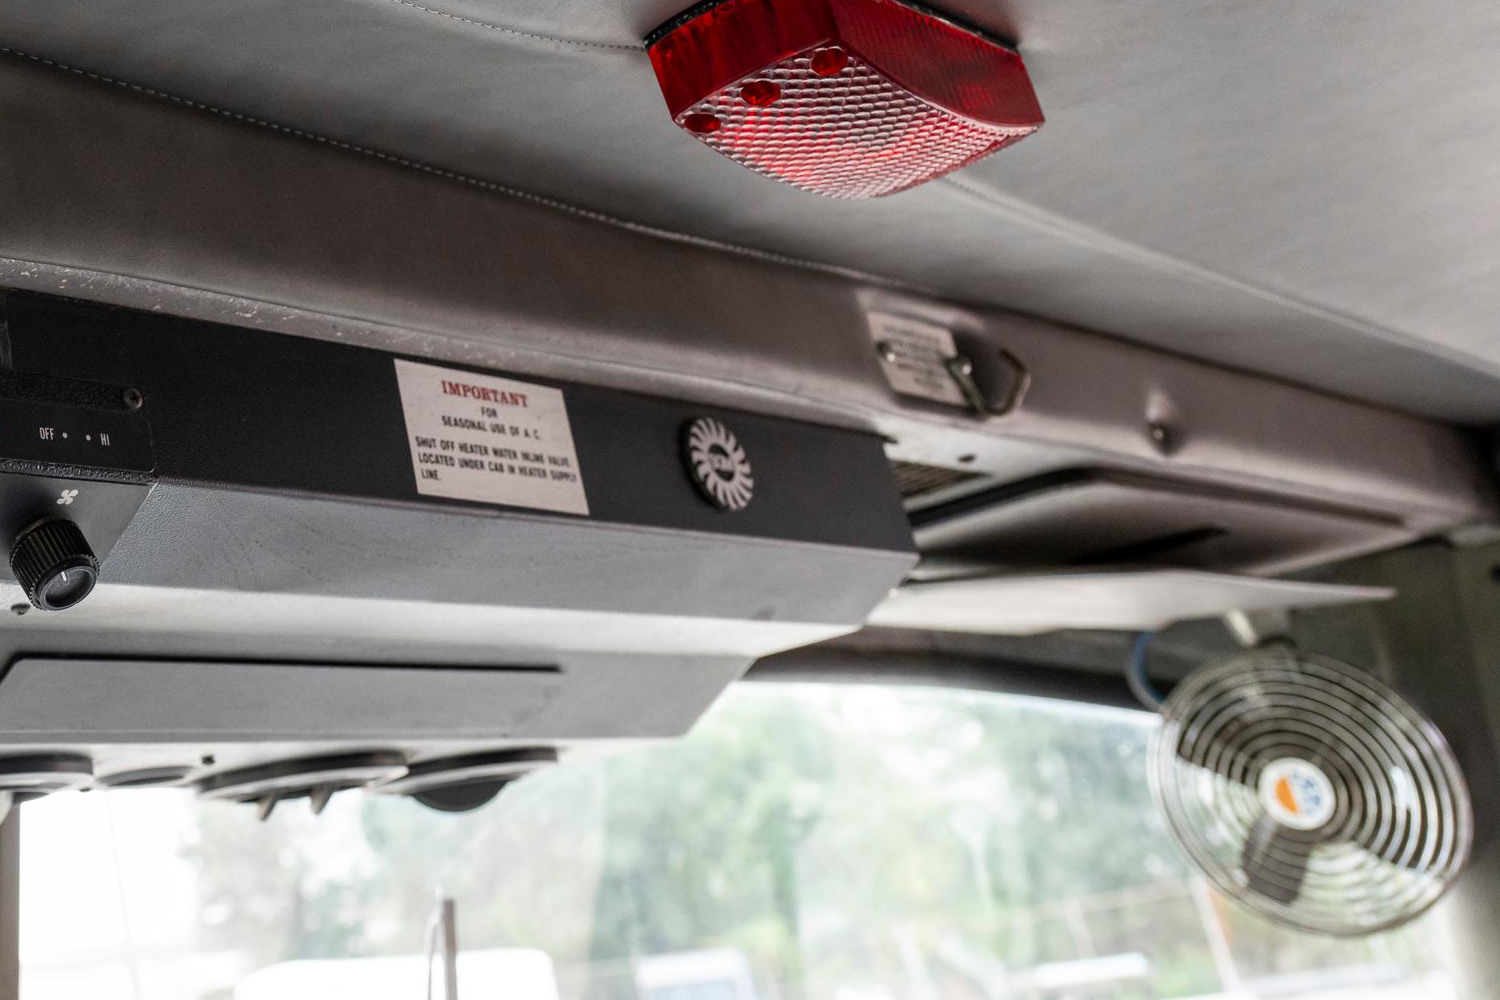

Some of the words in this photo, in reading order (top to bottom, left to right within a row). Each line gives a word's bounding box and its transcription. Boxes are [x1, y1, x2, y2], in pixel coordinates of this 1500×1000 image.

[440, 380, 528, 408] IMPORTANT
[481, 406, 498, 418] FOR
[39, 426, 54, 441] OFF
[100, 433, 110, 446] HI
[441, 415, 487, 432] SEASONAL
[490, 423, 506, 435] USE
[509, 426, 519, 437] OF
[415, 436, 436, 449] SHUT
[440, 439, 454, 451] OFF
[458, 443, 489, 455] HEATER
[492, 447, 518, 460] WATER
[418, 452, 455, 467] LOCATED
[458, 458, 485, 471] UNDER
[488, 461, 505, 474] CAB
[507, 464, 516, 475] IN
[518, 466, 548, 479] HEATER
[550, 469, 577, 483] SUPPLY
